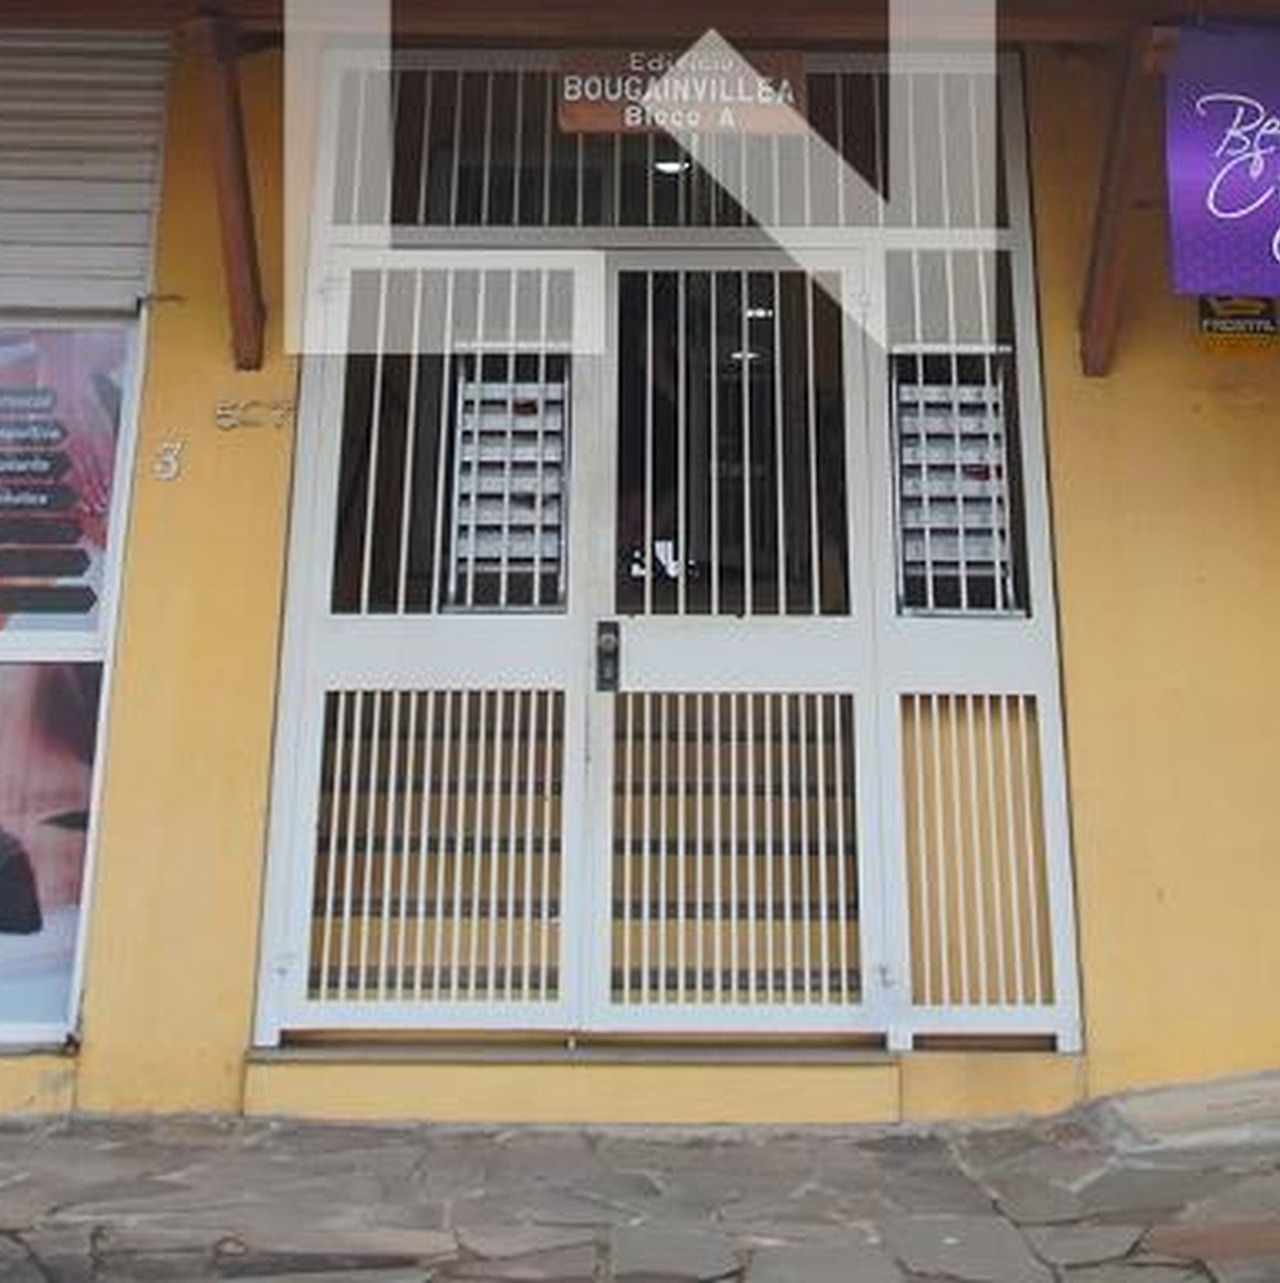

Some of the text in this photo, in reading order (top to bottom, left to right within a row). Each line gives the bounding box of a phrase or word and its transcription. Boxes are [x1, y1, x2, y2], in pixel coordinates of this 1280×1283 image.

[564, 75, 794, 104] BOUGAINVILLEA
[624, 106, 736, 128] Bloco A
